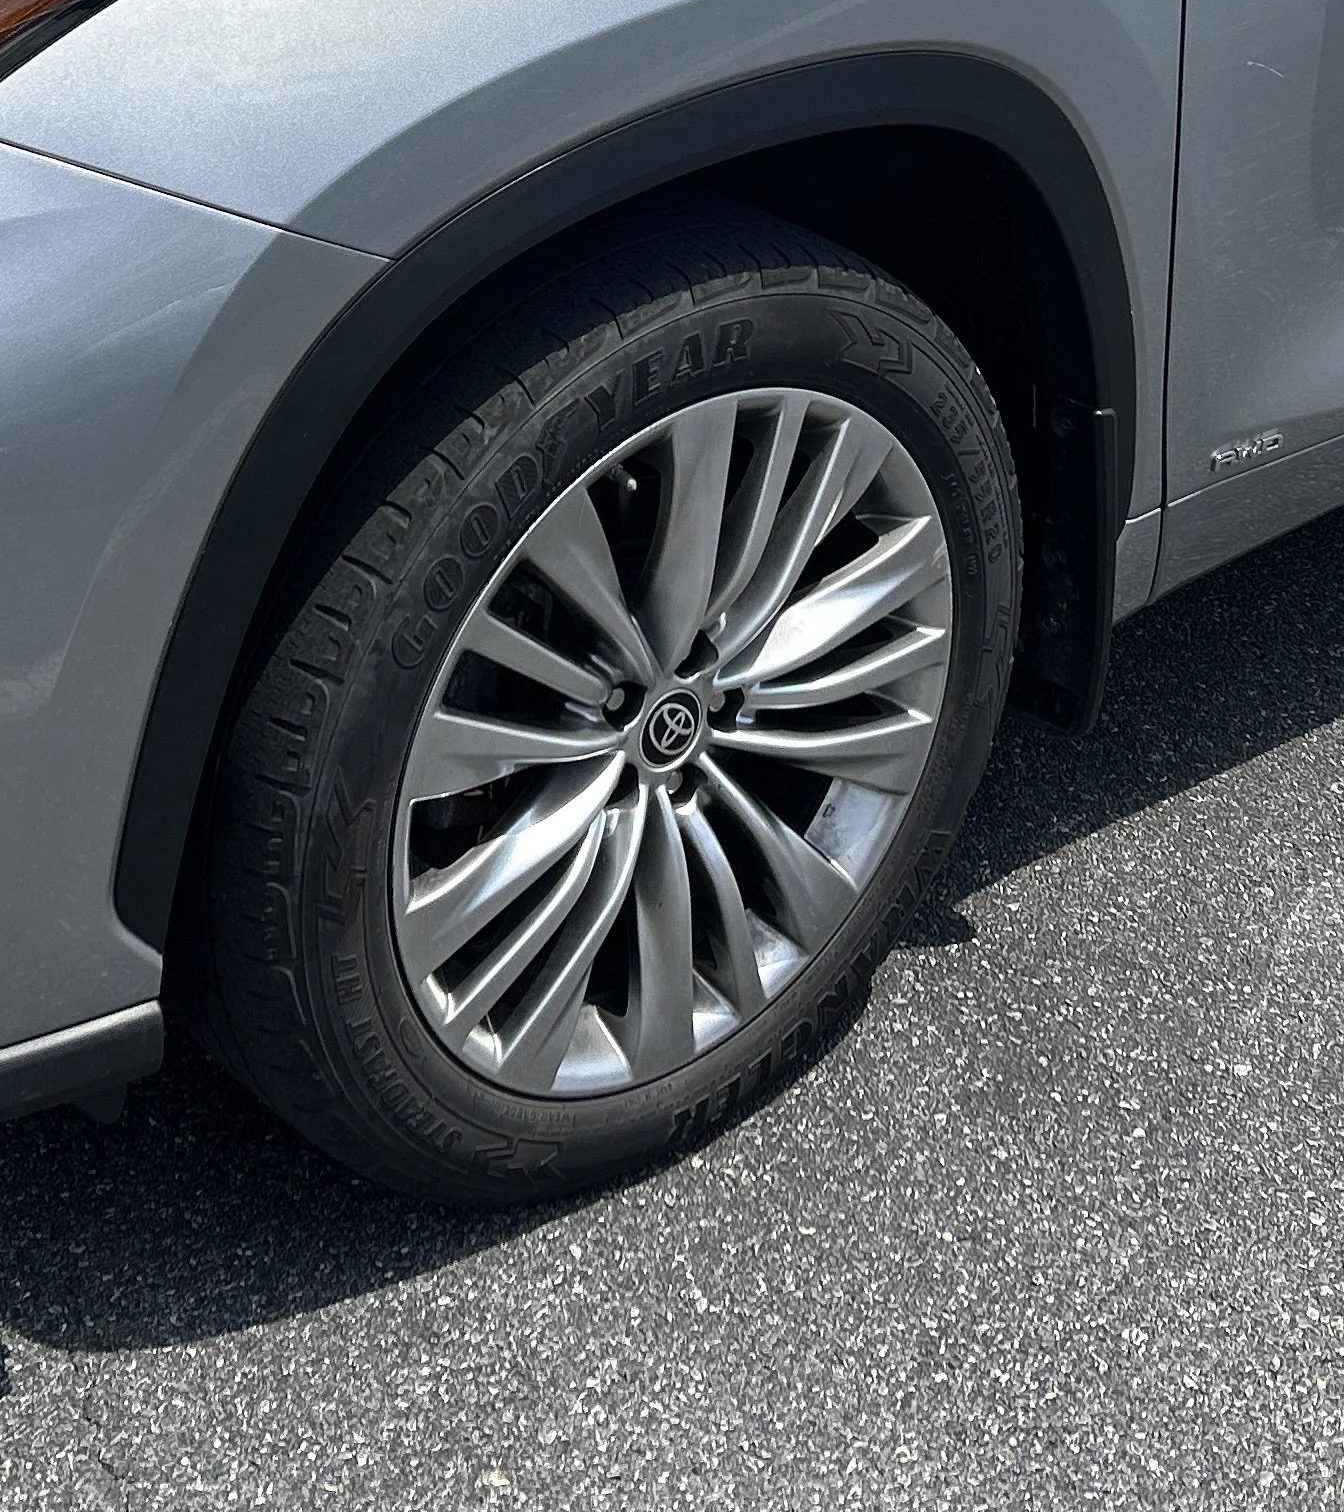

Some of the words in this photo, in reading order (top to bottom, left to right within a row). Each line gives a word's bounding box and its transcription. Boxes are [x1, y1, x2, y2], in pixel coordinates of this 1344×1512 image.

[391, 317, 755, 669] GOODYEAR
[930, 391, 1003, 564] 235/55R20
[330, 951, 363, 1006] HT
